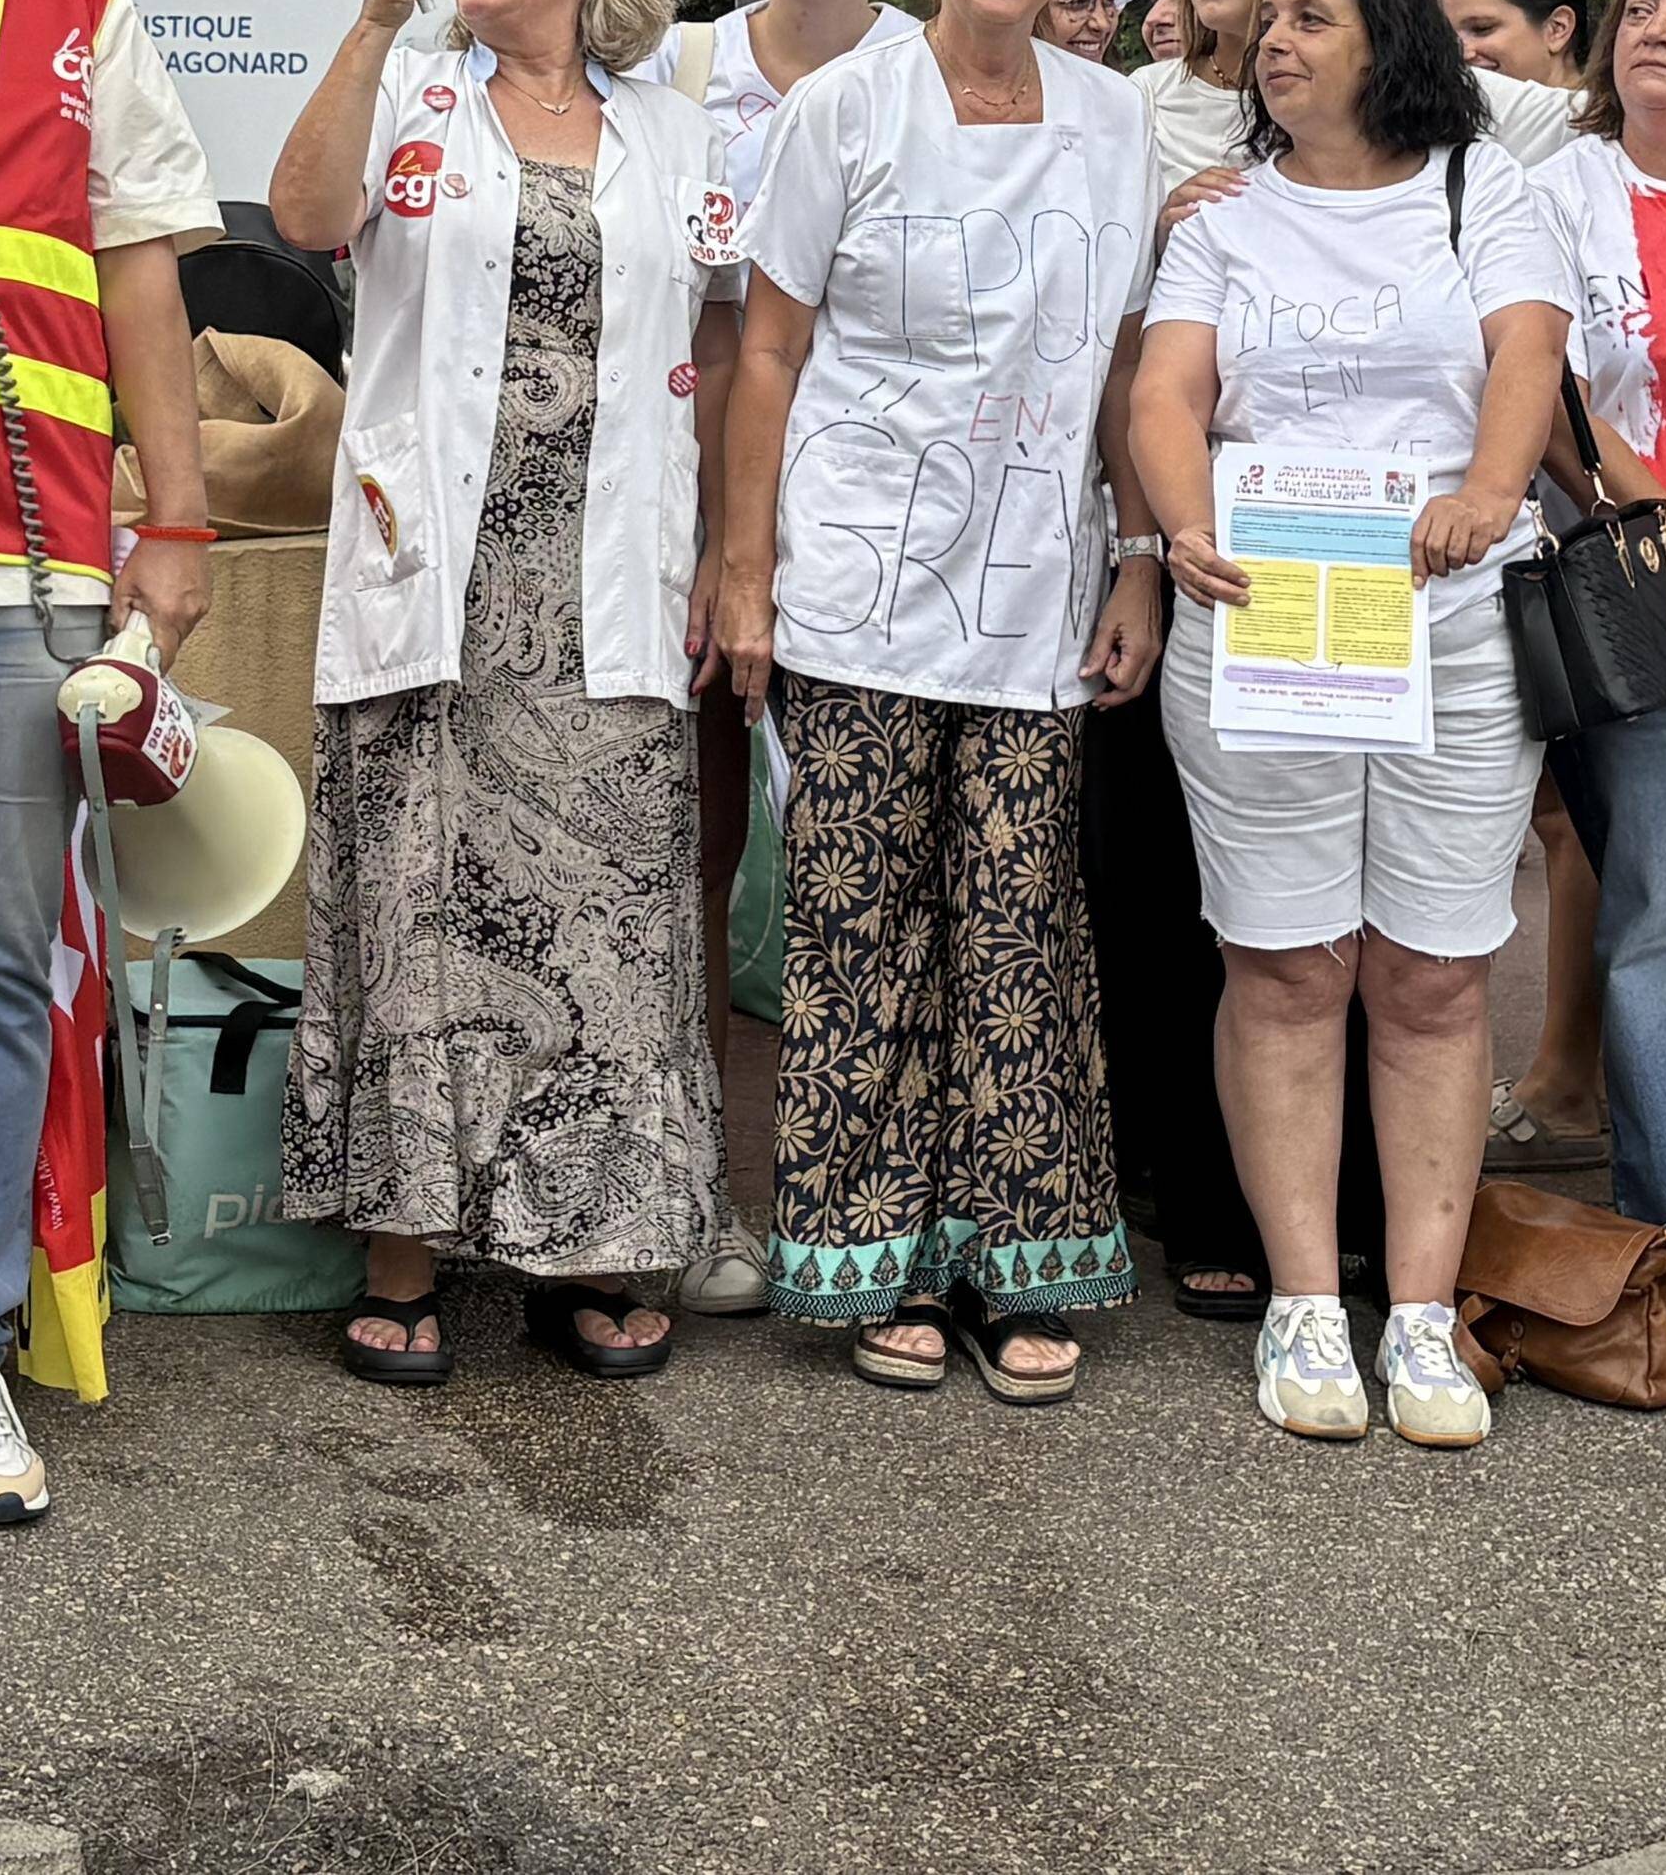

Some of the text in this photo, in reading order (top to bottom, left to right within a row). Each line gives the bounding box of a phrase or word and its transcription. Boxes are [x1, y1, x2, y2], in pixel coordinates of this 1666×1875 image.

[52, 52, 93, 102] cg
[161, 50, 308, 75] AGONARD
[1236, 283, 1404, 359] IPOCA
[1301, 354, 1365, 412] EN
[969, 391, 1053, 443] EN
